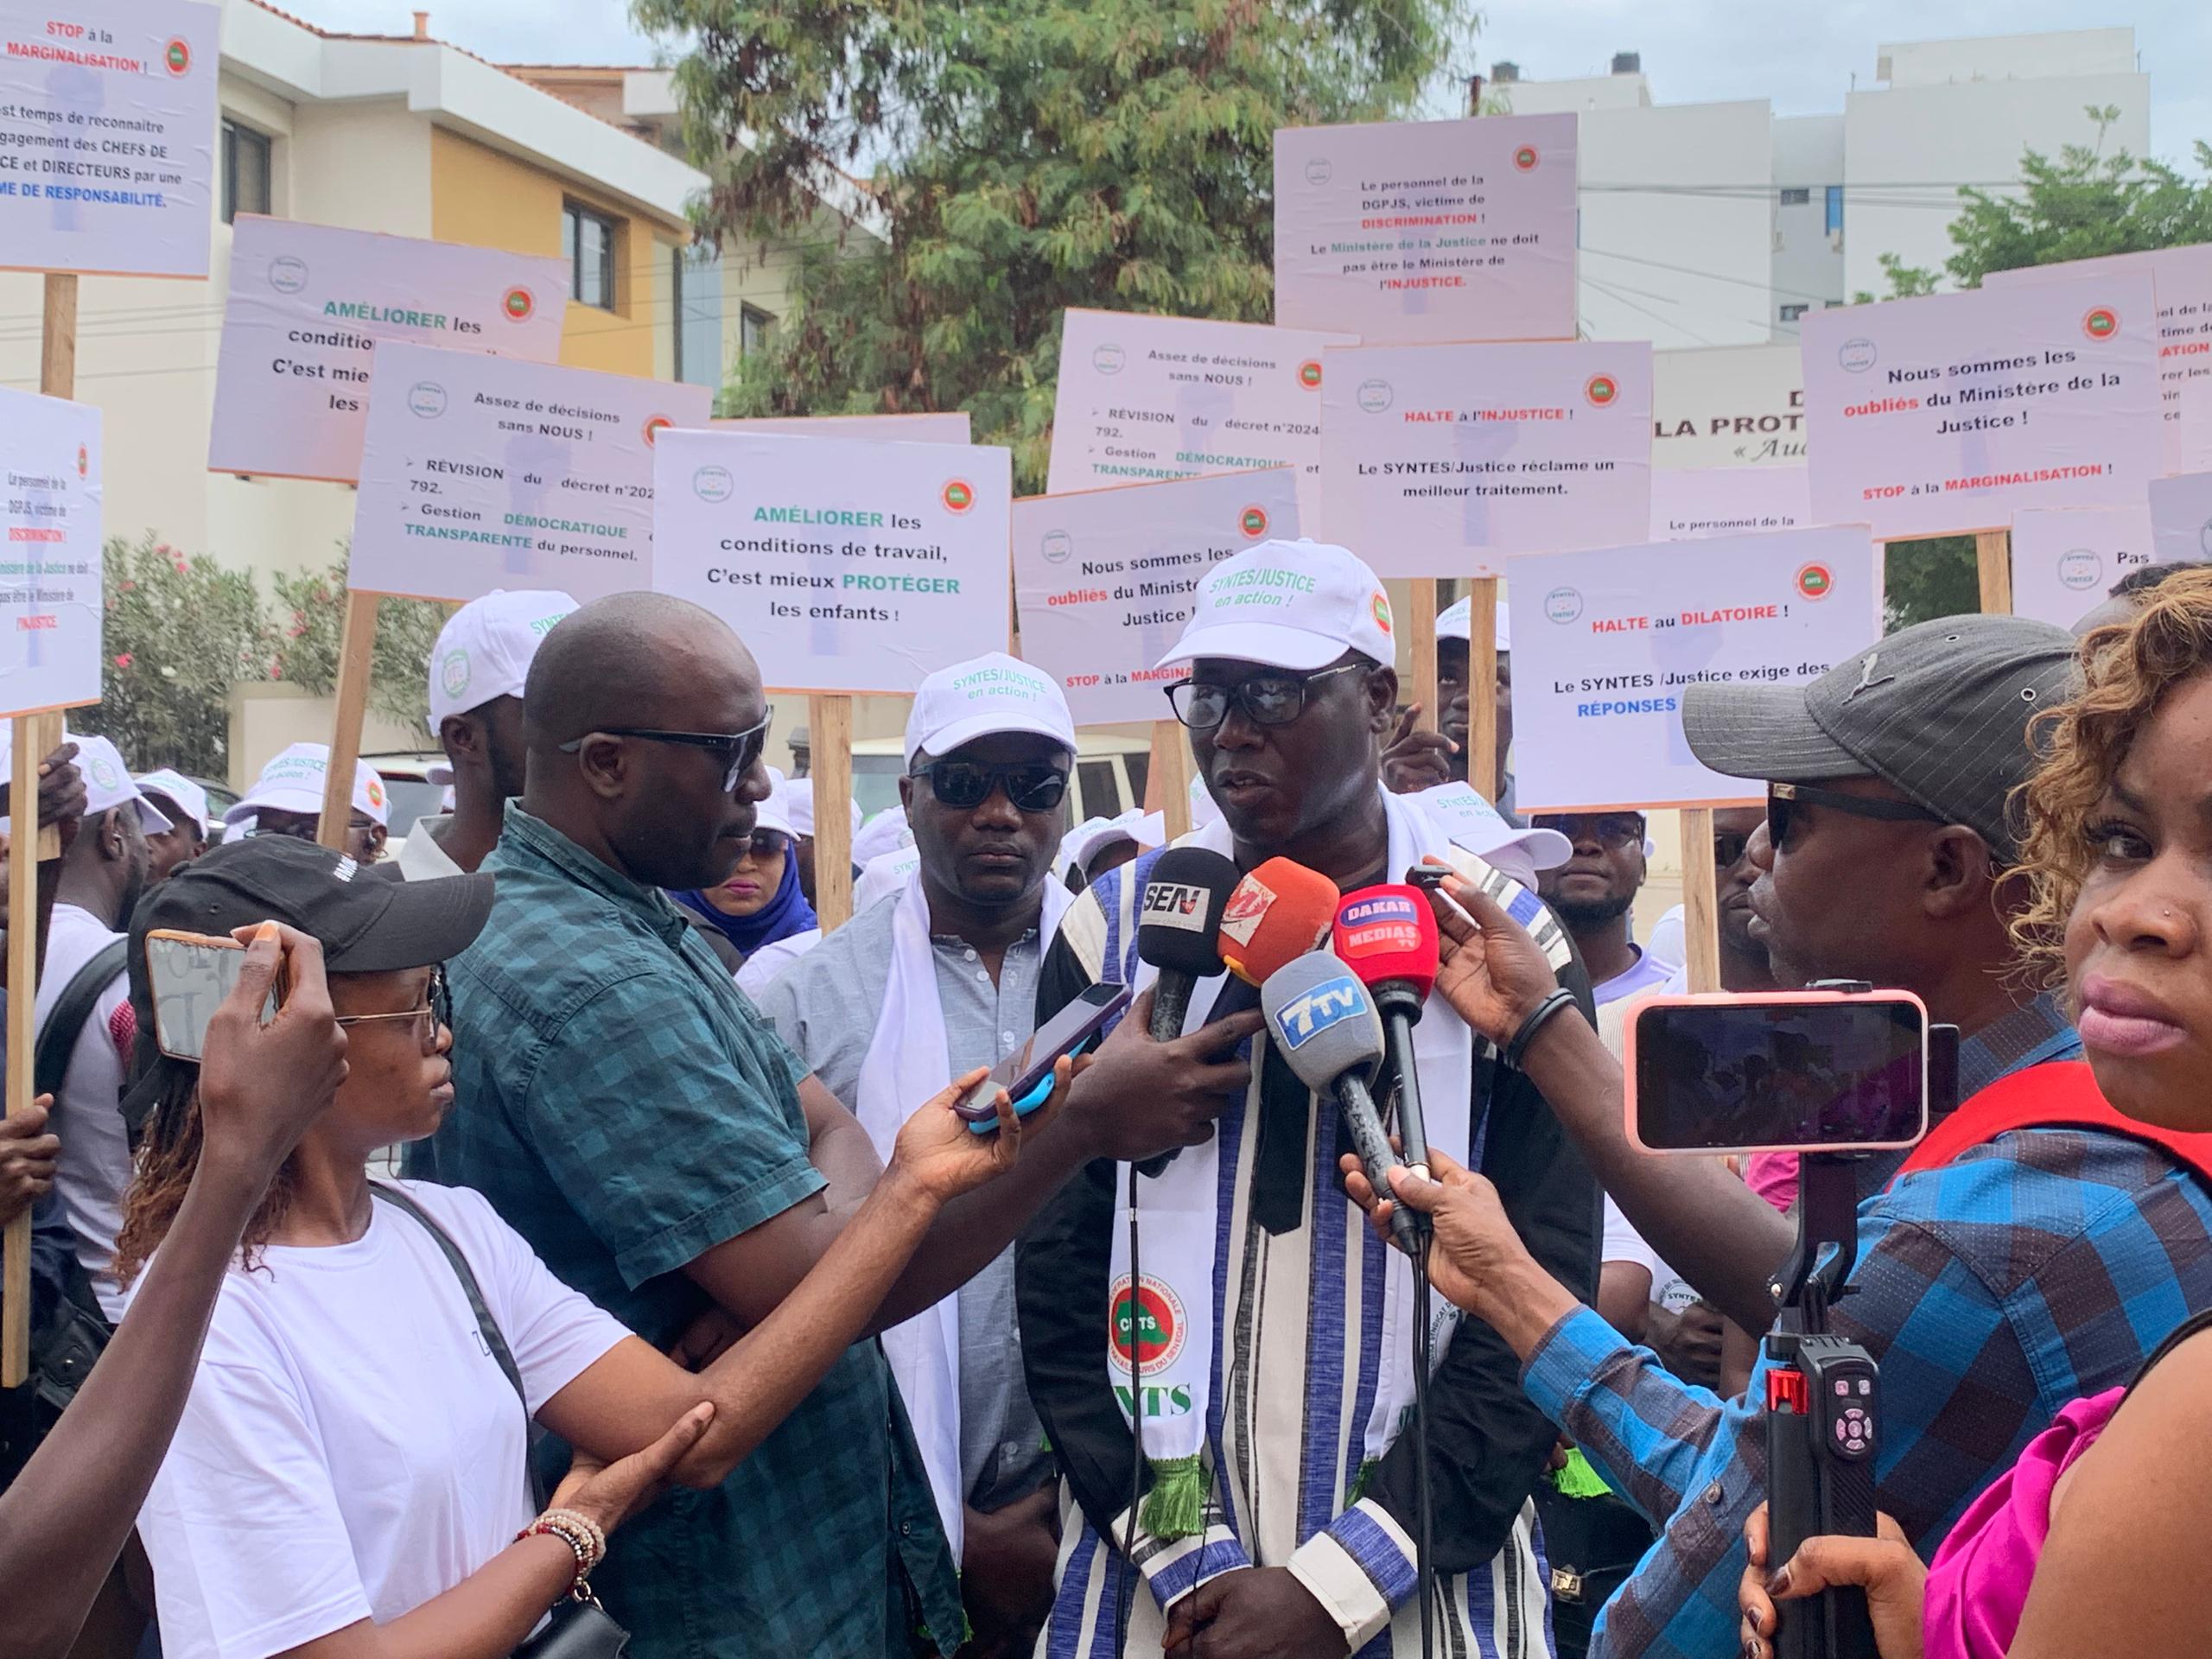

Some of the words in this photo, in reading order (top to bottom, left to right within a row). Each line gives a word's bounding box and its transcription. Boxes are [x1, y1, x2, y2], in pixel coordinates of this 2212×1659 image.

[46, 21, 84, 39] STOP
[87, 29, 97, 41] à
[100, 30, 113, 43] la
[6, 41, 140, 72] MARGINALISATION
[20, 106, 63, 124] temps
[67, 111, 85, 124] de
[73, 137, 98, 152] des
[101, 140, 146, 156] CHEFS
[149, 145, 168, 158] DE
[22, 159, 38, 171] et
[42, 160, 130, 180] DIRECTEURS
[133, 170, 156, 184] par
[158, 173, 182, 185] une
[1360, 181, 1377, 192] Le
[1380, 176, 1447, 194] personnel
[1450, 175, 1469, 186] de
[1471, 175, 1484, 185] la
[21, 184, 41, 197] DE
[44, 185, 168, 208] RESPONSABILITÉ.
[1361, 198, 1412, 211] DGPJS,
[1414, 195, 1465, 208] victime
[1468, 194, 1485, 205] de
[1360, 213, 1478, 230] DISCRIMINATION
[1310, 244, 1327, 256] Le
[1330, 240, 1394, 254] Ministère
[1397, 238, 1415, 251] de
[1418, 238, 1432, 250] la
[1435, 236, 1488, 249] Justice
[1490, 237, 1509, 246] ne
[1511, 234, 1541, 245] doit
[1342, 263, 1367, 275] pas
[1370, 259, 1399, 272] être
[1402, 259, 1415, 270] le
[1419, 256, 1484, 269] Ministère
[1487, 255, 1506, 266] de
[323, 300, 448, 331] AMÉLIORER
[452, 316, 483, 335] les
[2178, 305, 2197, 315] de
[288, 330, 377, 351] conditio
[1147, 349, 1189, 363] Assez
[1191, 353, 1209, 365] de
[1211, 354, 1277, 369] décisions
[1887, 368, 1942, 385] Nous
[1948, 356, 2037, 378] sommes
[2044, 349, 2077, 365] les
[271, 359, 326, 378] C'est
[332, 367, 370, 383] mie
[1167, 372, 1200, 383] sans
[1204, 373, 1243, 385] NOUS
[2188, 368, 2211, 378] les
[328, 395, 359, 411] les
[1843, 397, 1920, 418] oubliés
[1926, 392, 1952, 409] du
[1958, 379, 2060, 404] Ministère
[2067, 374, 2094, 391] de
[2100, 372, 2121, 387] la
[473, 392, 521, 410] Assez
[524, 399, 544, 412] de
[548, 402, 621, 424] décisions
[1403, 410, 1455, 423] HALTE
[1458, 409, 1469, 422] à
[1471, 408, 1565, 422] l'INJUSTICE
[497, 419, 535, 434] sans
[538, 423, 584, 440] NOUS
[1108, 407, 1175, 423] RÉVISION
[1191, 416, 1209, 428] du
[1224, 419, 1270, 432] décret
[1654, 421, 1698, 439] LA
[1936, 415, 2016, 435] Justice
[1094, 427, 1123, 438] 792.
[1104, 447, 1158, 460] Gestion
[1305, 464, 1320, 474] et
[1357, 462, 1378, 475] Le
[1382, 461, 1516, 474] SYNTES/Justice
[1521, 460, 1590, 473] réclame
[1593, 461, 1616, 471] un
[426, 457, 505, 480] RÉVISION
[523, 472, 543, 485] du
[561, 476, 611, 495] décret
[1862, 486, 1906, 501] STOP
[1924, 480, 1940, 494] la
[1944, 464, 2103, 491] MARGINALISATION
[409, 480, 444, 495] 792.
[1402, 484, 1471, 499] meilleur
[1474, 482, 1569, 495] traitement.
[420, 503, 483, 521] Gestion
[503, 512, 628, 539] DÉMOCRATIQUE
[753, 505, 885, 527] AMÉLIORER
[891, 513, 923, 530] les
[1669, 520, 1685, 531] Le
[1689, 518, 1758, 531] personnel
[1760, 517, 1778, 526] de
[1781, 517, 1795, 525] la
[404, 523, 533, 549] TRANSPARENTE
[537, 538, 556, 552] du
[559, 543, 639, 563] personnel.
[720, 537, 834, 556] conditions
[841, 541, 868, 557] de
[874, 543, 949, 563] travail,
[1081, 562, 1125, 575] Nous
[1129, 552, 1203, 570] sommes
[1207, 548, 1234, 562] les
[2116, 552, 2150, 564] Pas
[706, 568, 763, 586] C'est
[769, 574, 836, 588] mieux
[842, 573, 961, 594] PROTÉGER
[1209, 568, 1317, 594] SYNTES/JUSTICE
[1047, 590, 1109, 606] oubliés
[1113, 586, 1135, 600] du
[1215, 596, 1231, 607] en
[1234, 591, 1283, 606] action
[769, 601, 802, 617] les
[808, 604, 890, 621] enfants
[1122, 610, 1186, 626] Justice
[1592, 616, 1649, 633] HALTE
[1654, 616, 1676, 630] au
[1680, 605, 1778, 626] DILATOIRE
[953, 668, 1046, 693] SYNTES/JUSTICE
[1065, 675, 1101, 688] STOP
[1116, 672, 1128, 683] la
[1554, 680, 1575, 694] Le
[1580, 674, 1655, 692] SYNTES
[1659, 669, 1733, 687] /Justice
[1738, 665, 1790, 681] exige
[1796, 662, 1831, 676] des
[968, 689, 984, 699] en
[988, 686, 1030, 698] action
[1577, 696, 1677, 717] RÉPONSES
[1347, 901, 1412, 921] DAKAR
[1348, 926, 1417, 947] MEDIAS
[1281, 987, 1354, 1036] 7TV
[1145, 1277, 1182, 1315] NATIONALE
[1119, 1316, 1157, 1332] CTS
